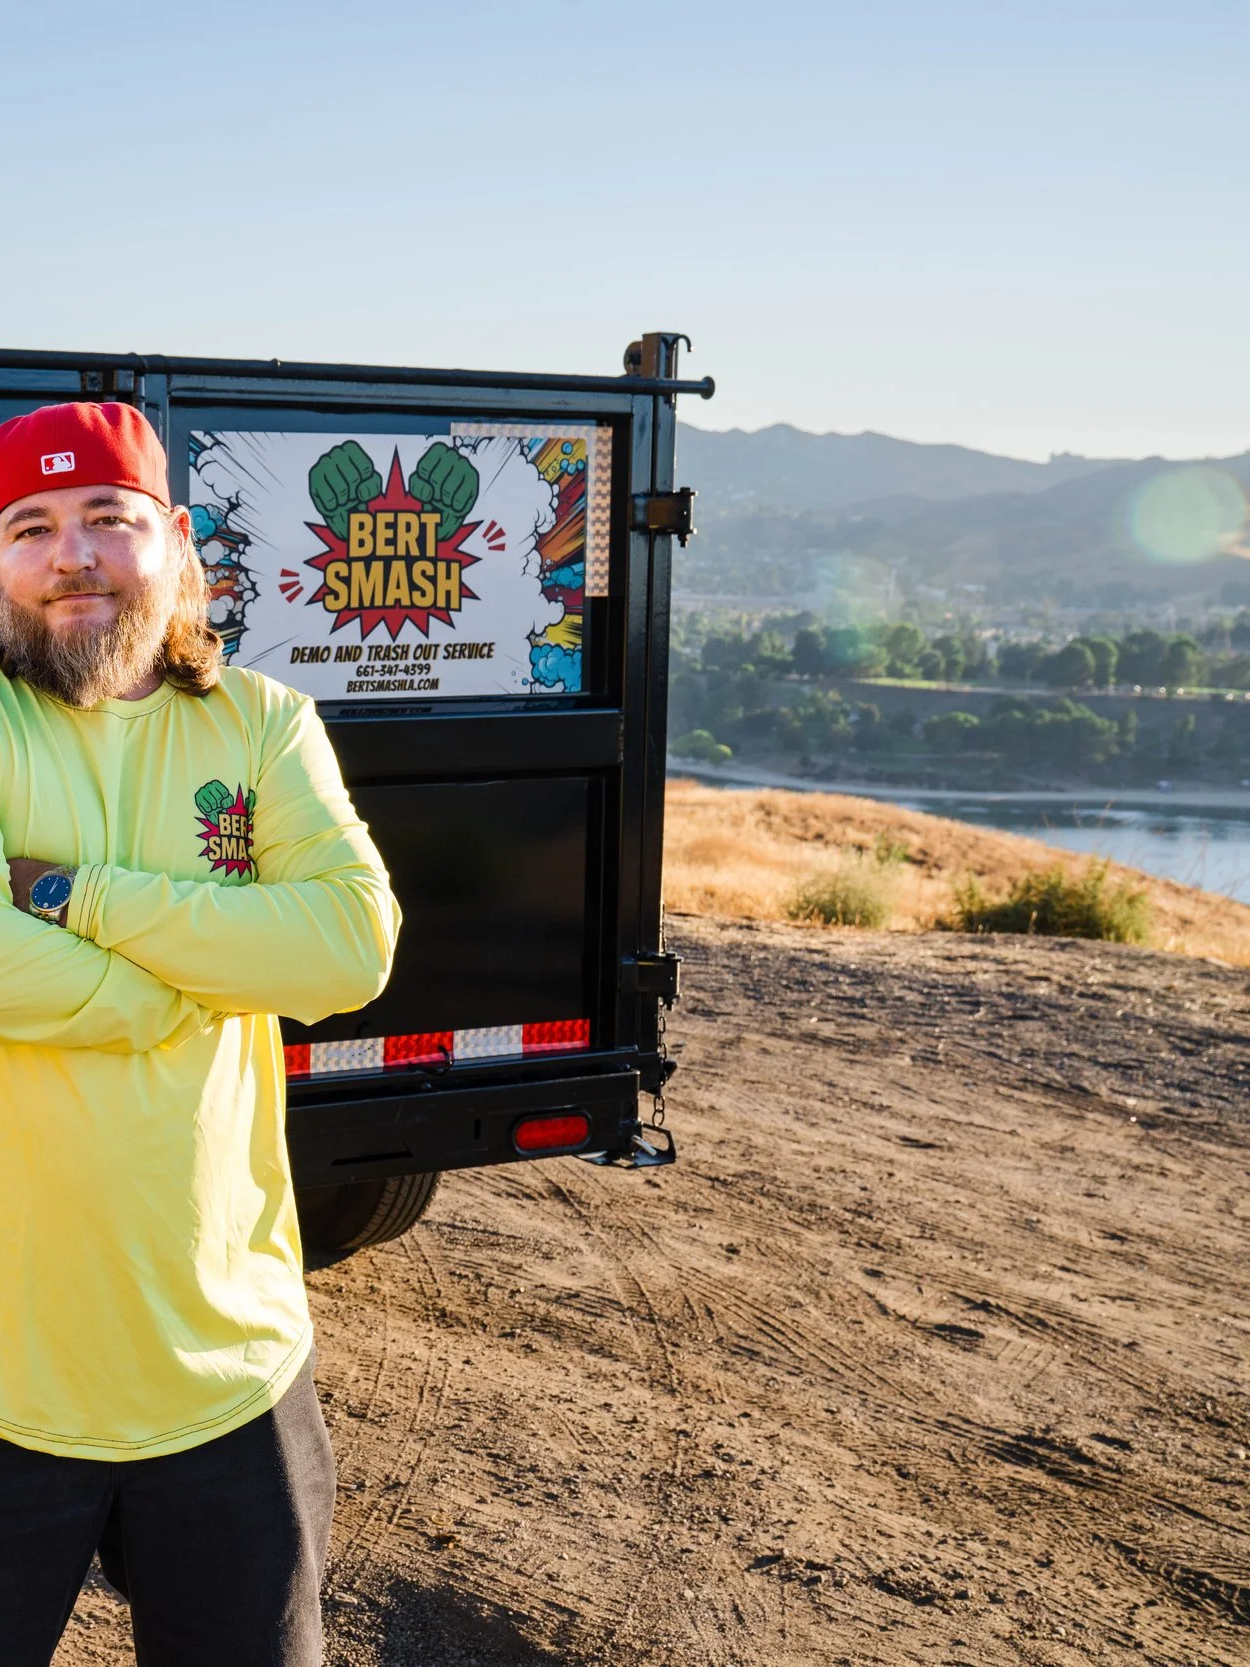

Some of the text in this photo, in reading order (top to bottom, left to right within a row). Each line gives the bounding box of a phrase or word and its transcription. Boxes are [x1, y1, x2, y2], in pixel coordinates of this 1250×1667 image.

[349, 511, 441, 558] BERT
[323, 560, 461, 612] SMASH
[290, 642, 495, 664] DEMO AND TRASH OUT SERVICE
[356, 663, 431, 677] 661-347-4399
[346, 678, 440, 693] BERTSMASHLA.COM
[218, 813, 248, 838] BER
[208, 836, 248, 861] SMA
